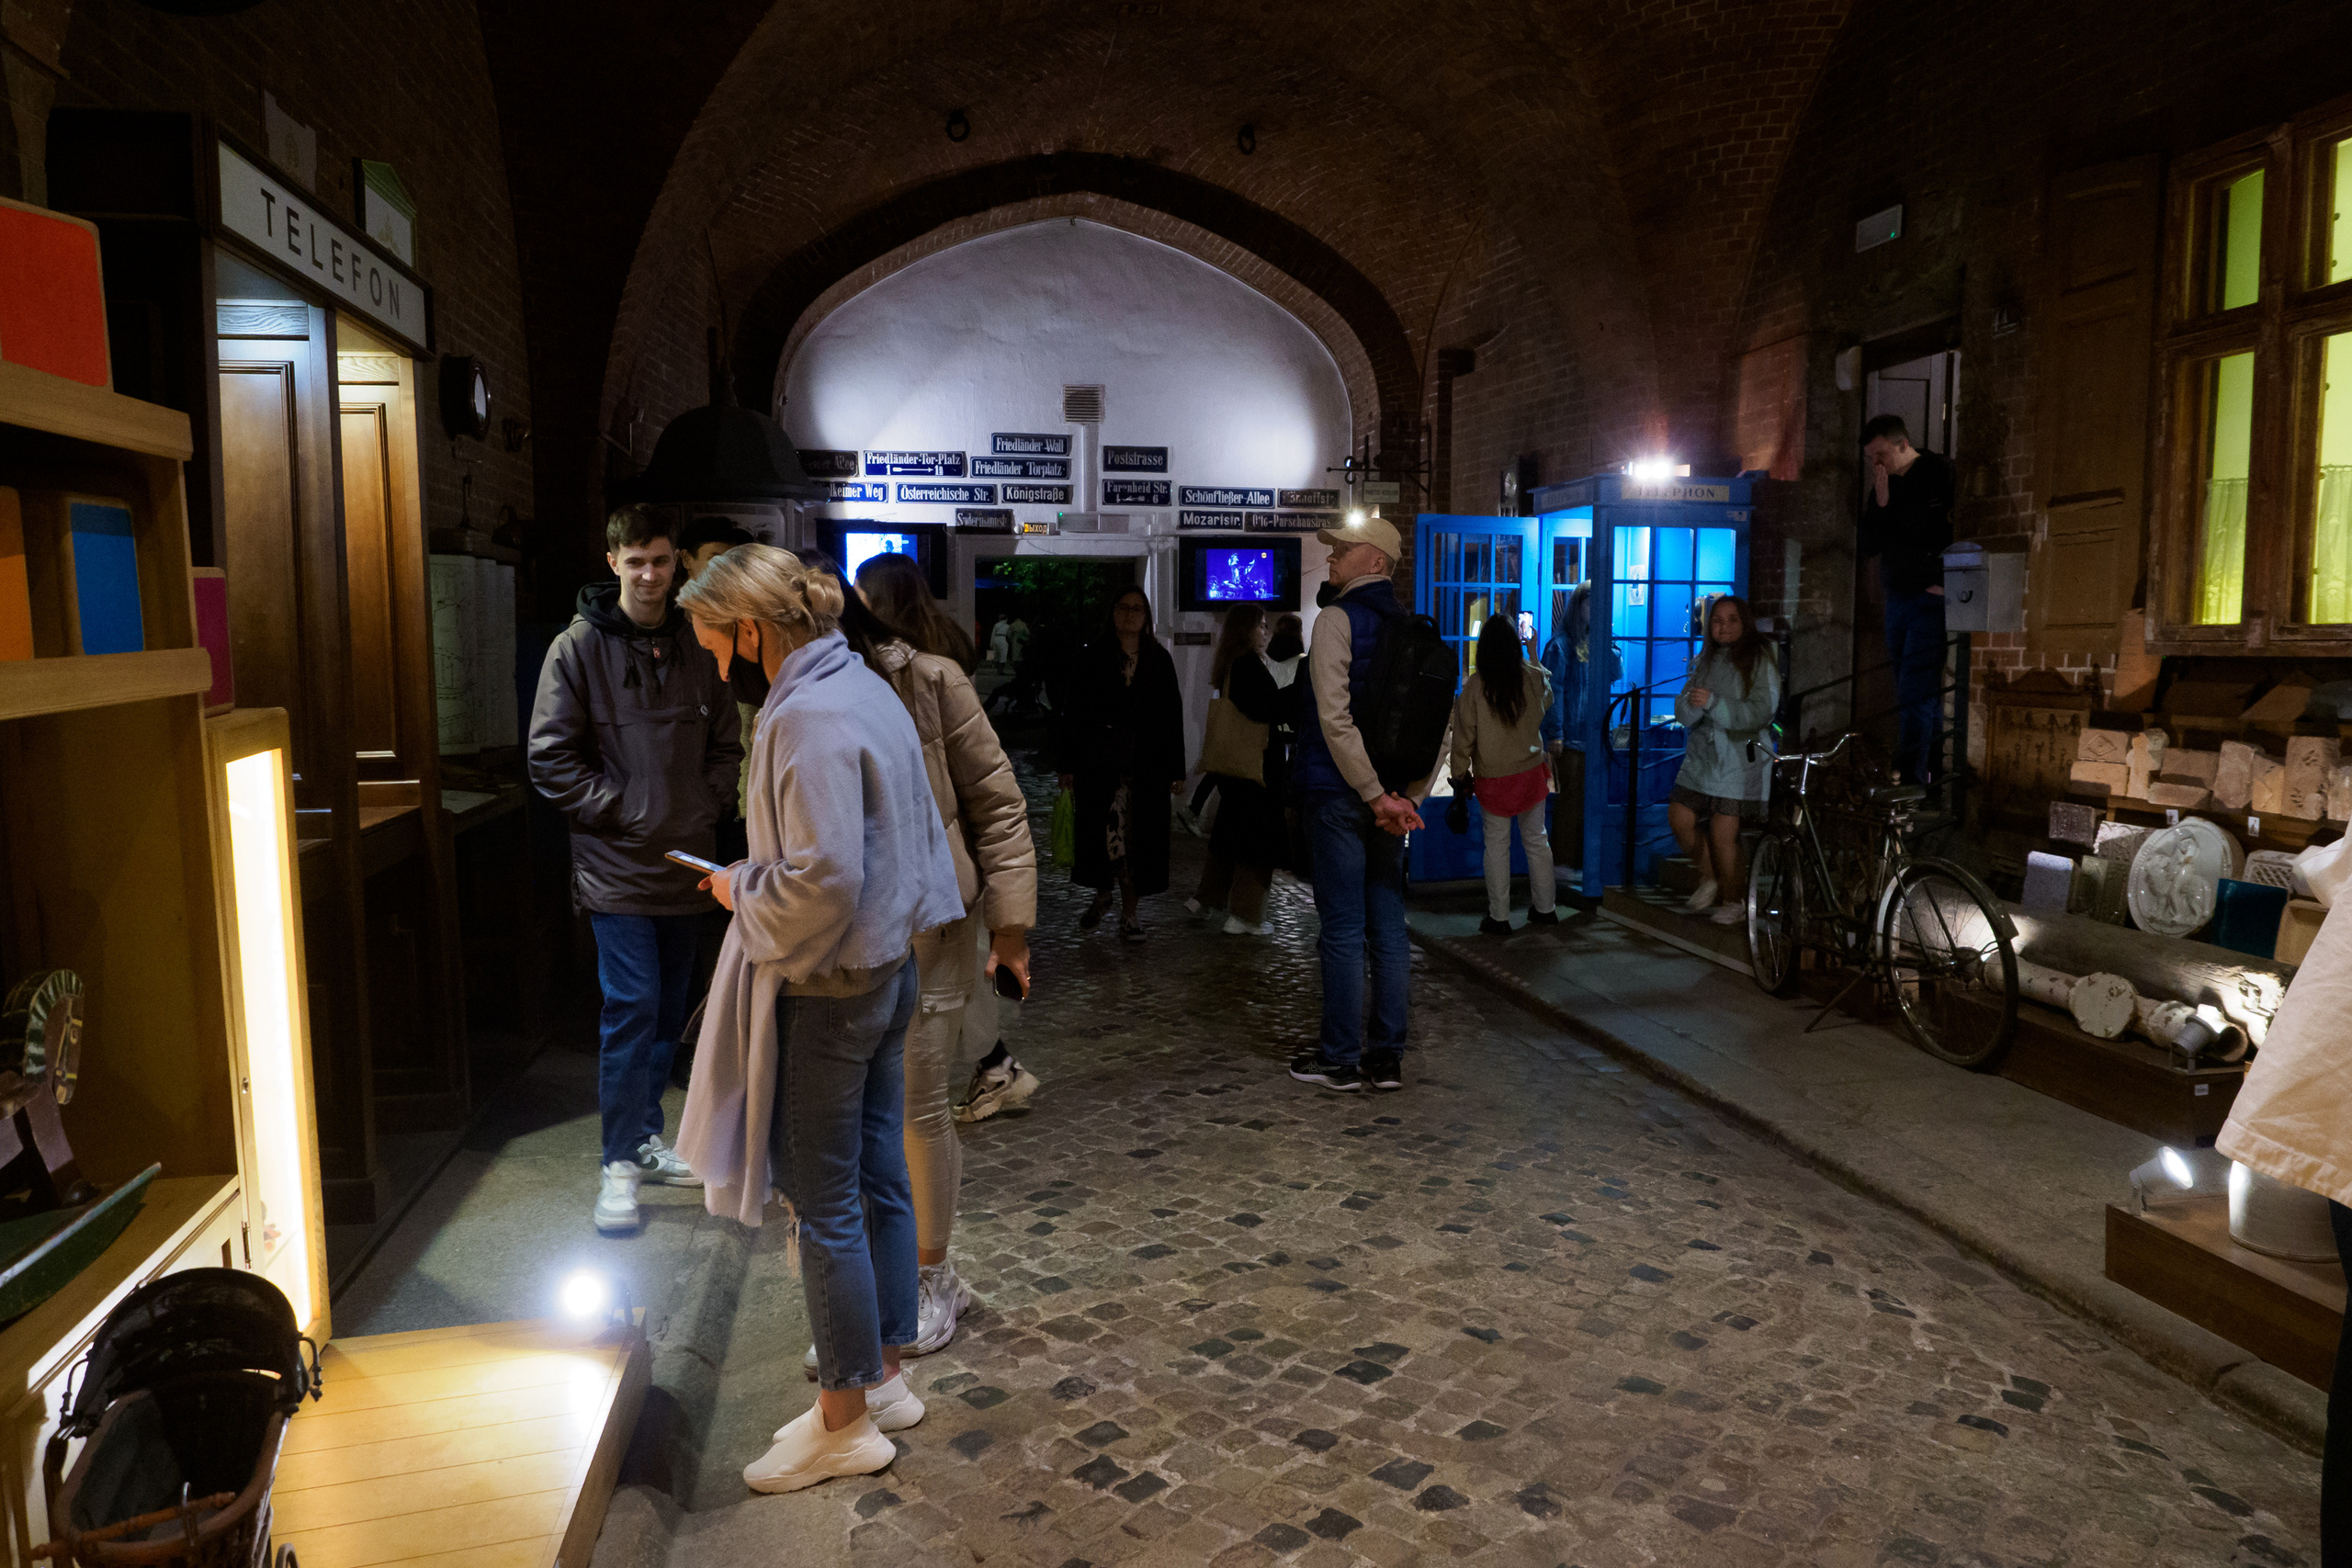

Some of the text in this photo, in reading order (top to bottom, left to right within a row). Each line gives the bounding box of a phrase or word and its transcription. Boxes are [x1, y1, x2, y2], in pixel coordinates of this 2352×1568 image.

[261, 187, 400, 319] TELEFON
[866, 452, 961, 465] Friedländer-Tor-Platz
[1108, 450, 1163, 466] Poststrasse
[886, 465, 891, 476] 1
[975, 460, 1062, 477] Friedländer Torplatz
[865, 483, 883, 501] Weg
[900, 485, 989, 502] Österreichische Str.
[1006, 487, 1064, 502] Königstraße
[1152, 494, 1159, 504] 6
[1185, 489, 1270, 505] Schönfließer-Allee
[1183, 513, 1240, 525] Mozartstr.
[1024, 524, 1047, 534] ВЫХОД
